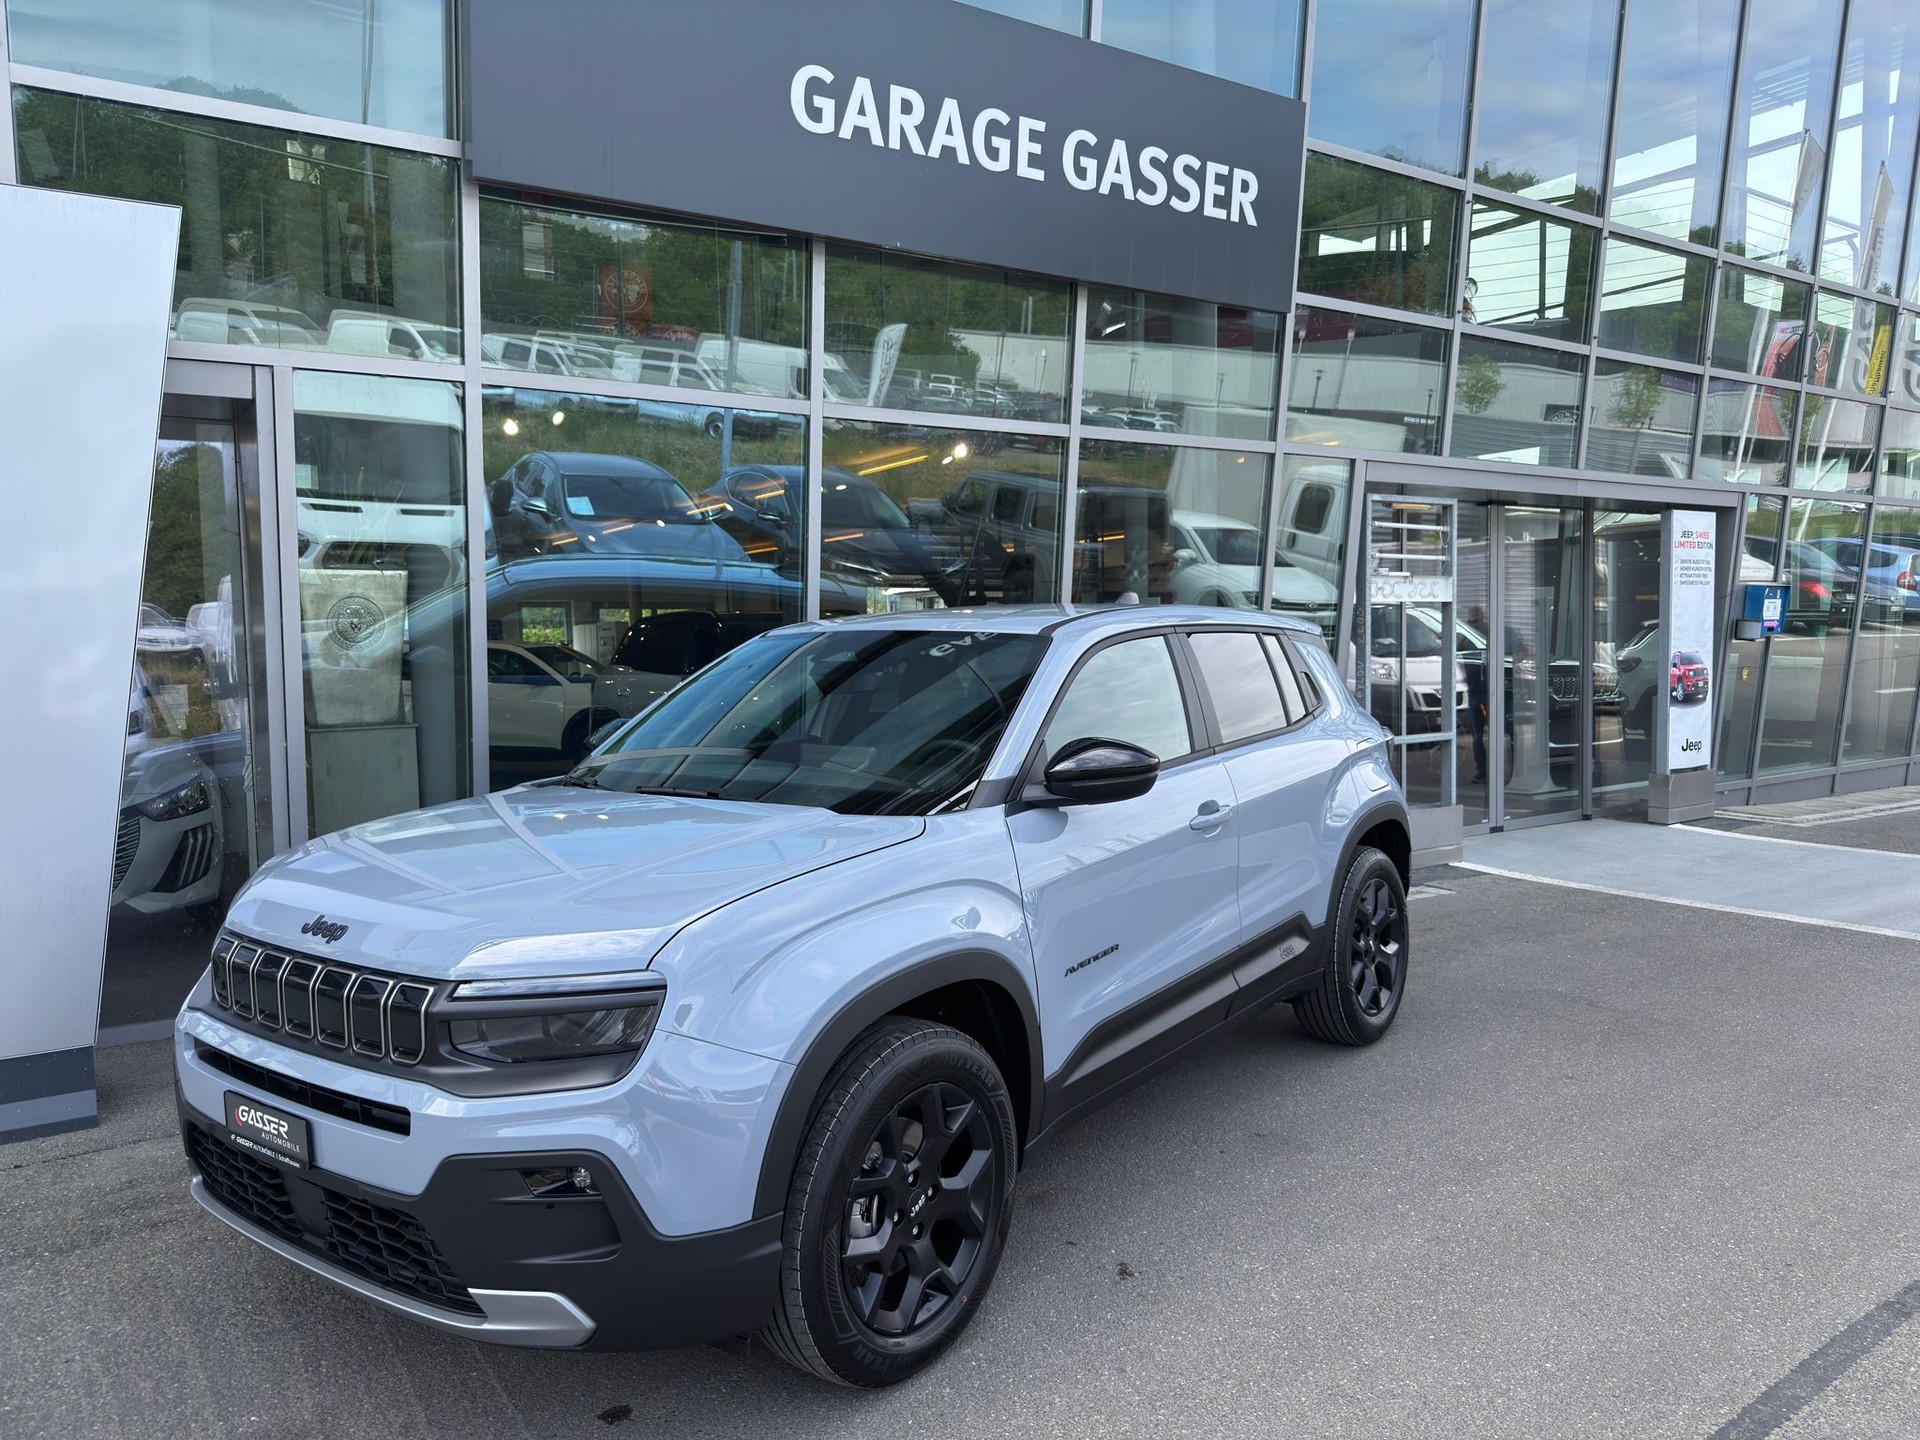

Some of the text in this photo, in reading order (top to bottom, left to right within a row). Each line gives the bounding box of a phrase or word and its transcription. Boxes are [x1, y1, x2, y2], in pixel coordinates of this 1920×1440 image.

[790, 64, 1259, 227] GARAGE GASSER
[1674, 541, 1714, 550] LIMITED EDITION
[1695, 531, 1710, 540] SWISS
[1681, 738, 1702, 753] Jeep
[301, 914, 349, 944] Jeep
[1064, 943, 1120, 977] AVENGER
[238, 1105, 289, 1139] GASSER
[261, 1131, 300, 1153] AUTOMOBILE
